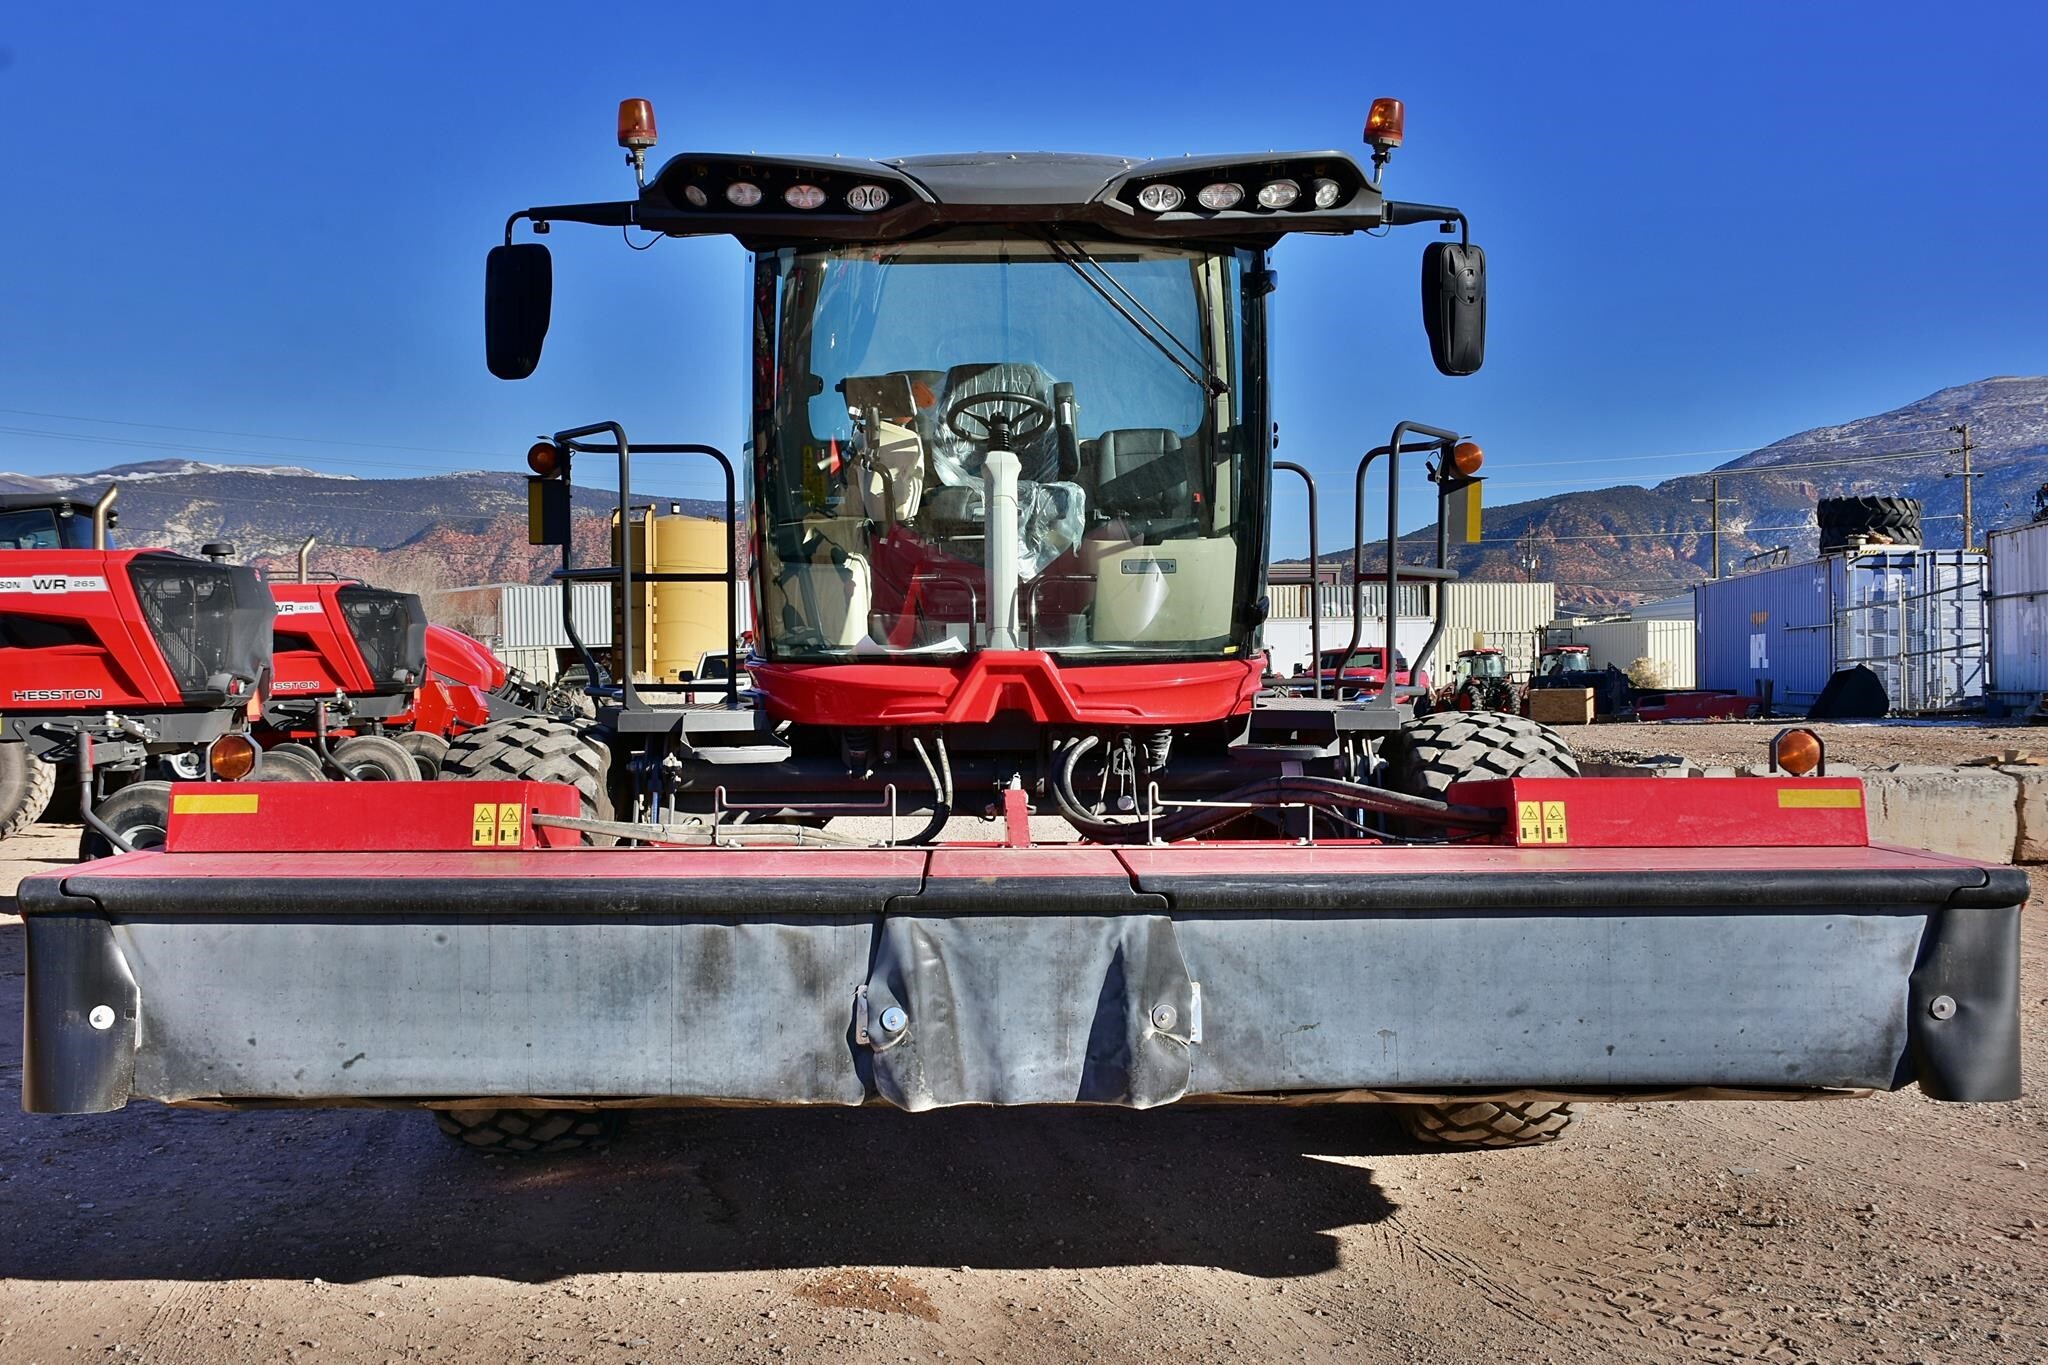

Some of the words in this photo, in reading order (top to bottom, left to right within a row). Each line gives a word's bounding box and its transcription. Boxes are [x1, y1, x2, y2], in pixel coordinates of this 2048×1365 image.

[32, 579, 67, 590] WR
[73, 580, 97, 588] 265
[272, 681, 320, 691] SSTON
[13, 688, 102, 701] HESSTON
